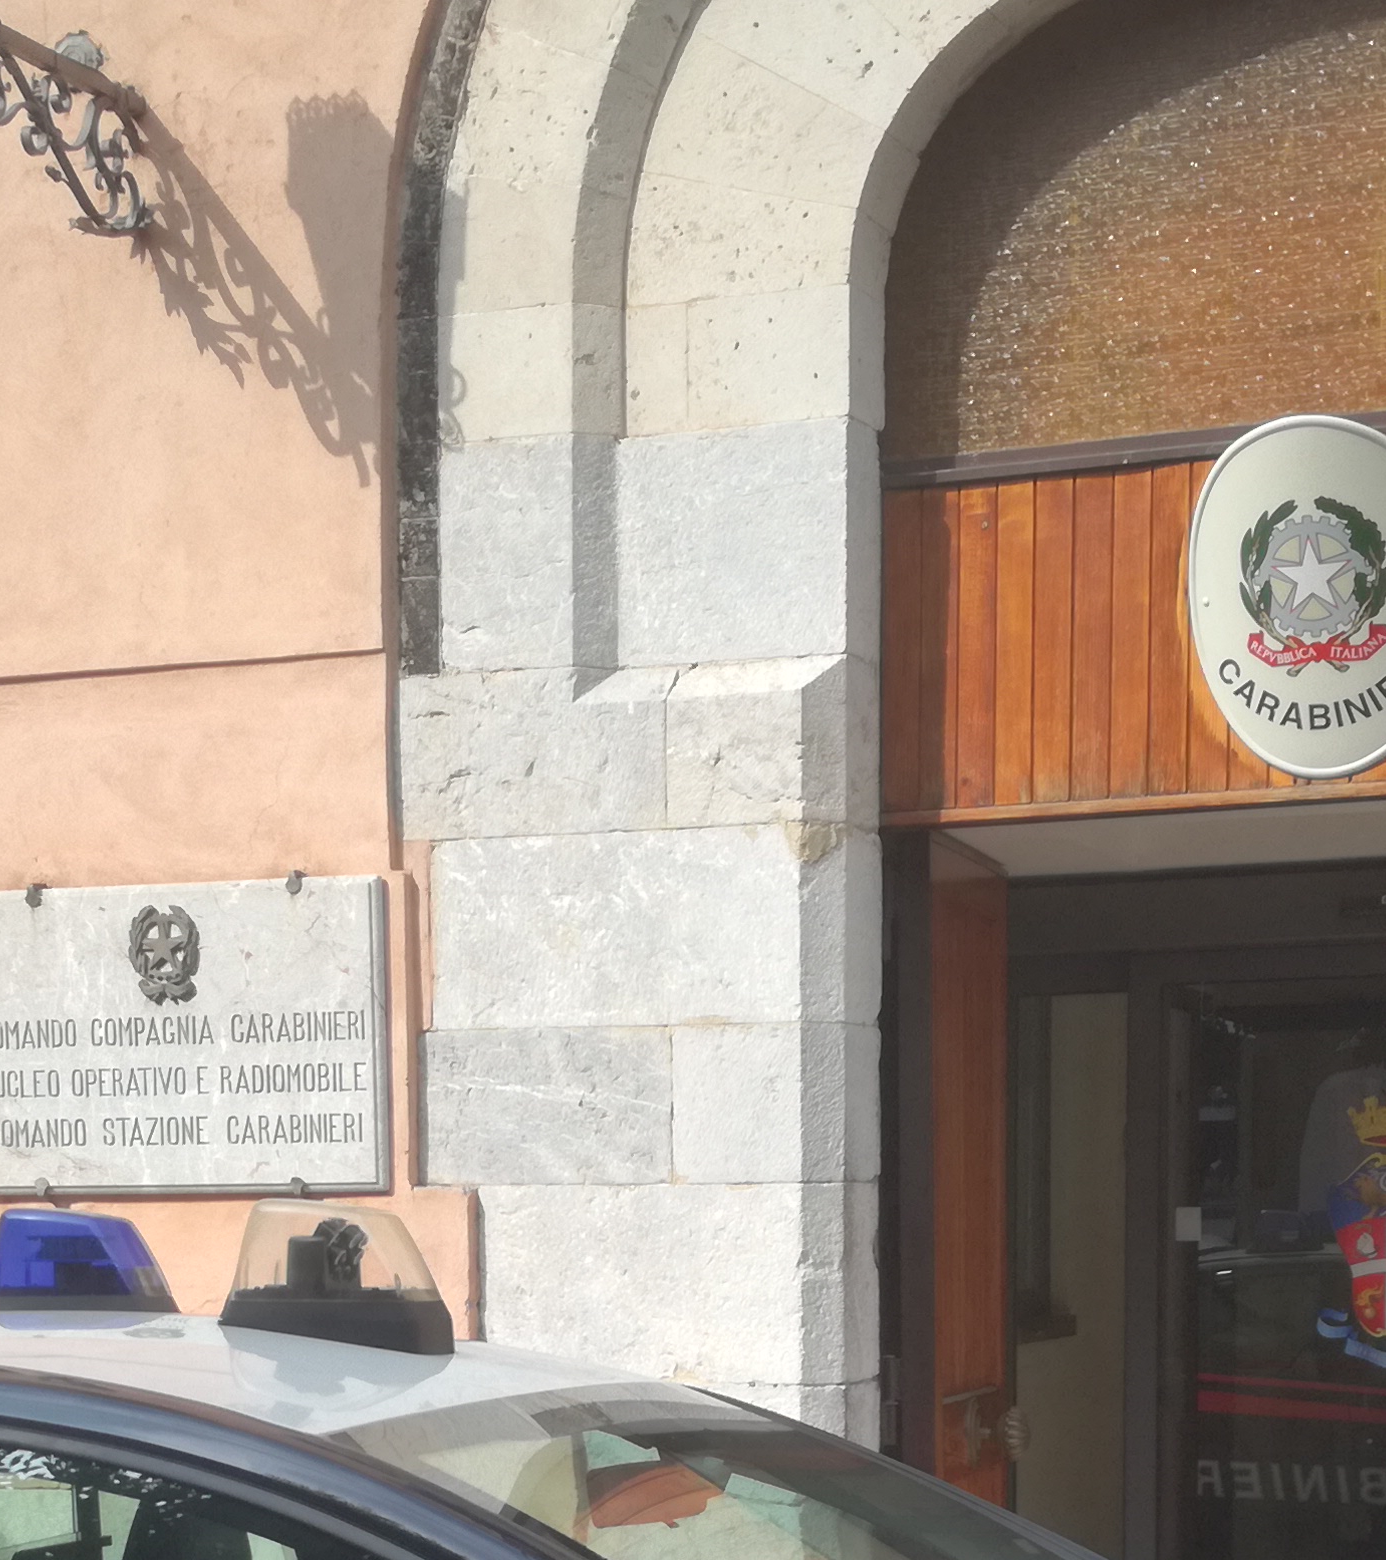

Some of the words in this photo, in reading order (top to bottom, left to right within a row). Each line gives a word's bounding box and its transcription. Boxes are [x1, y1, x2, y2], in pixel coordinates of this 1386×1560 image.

[1250, 640, 1317, 664] REPVBBLICA
[90, 1014, 214, 1047] COMPAGNIA
[230, 1009, 367, 1044] CARABINIERI
[71, 1066, 187, 1098] OPERATIVO
[197, 1066, 209, 1095] E
[219, 1061, 368, 1095] RADIOMOBILE
[103, 1115, 210, 1146] STAZIONE
[226, 1112, 364, 1145] CARABINIERI
